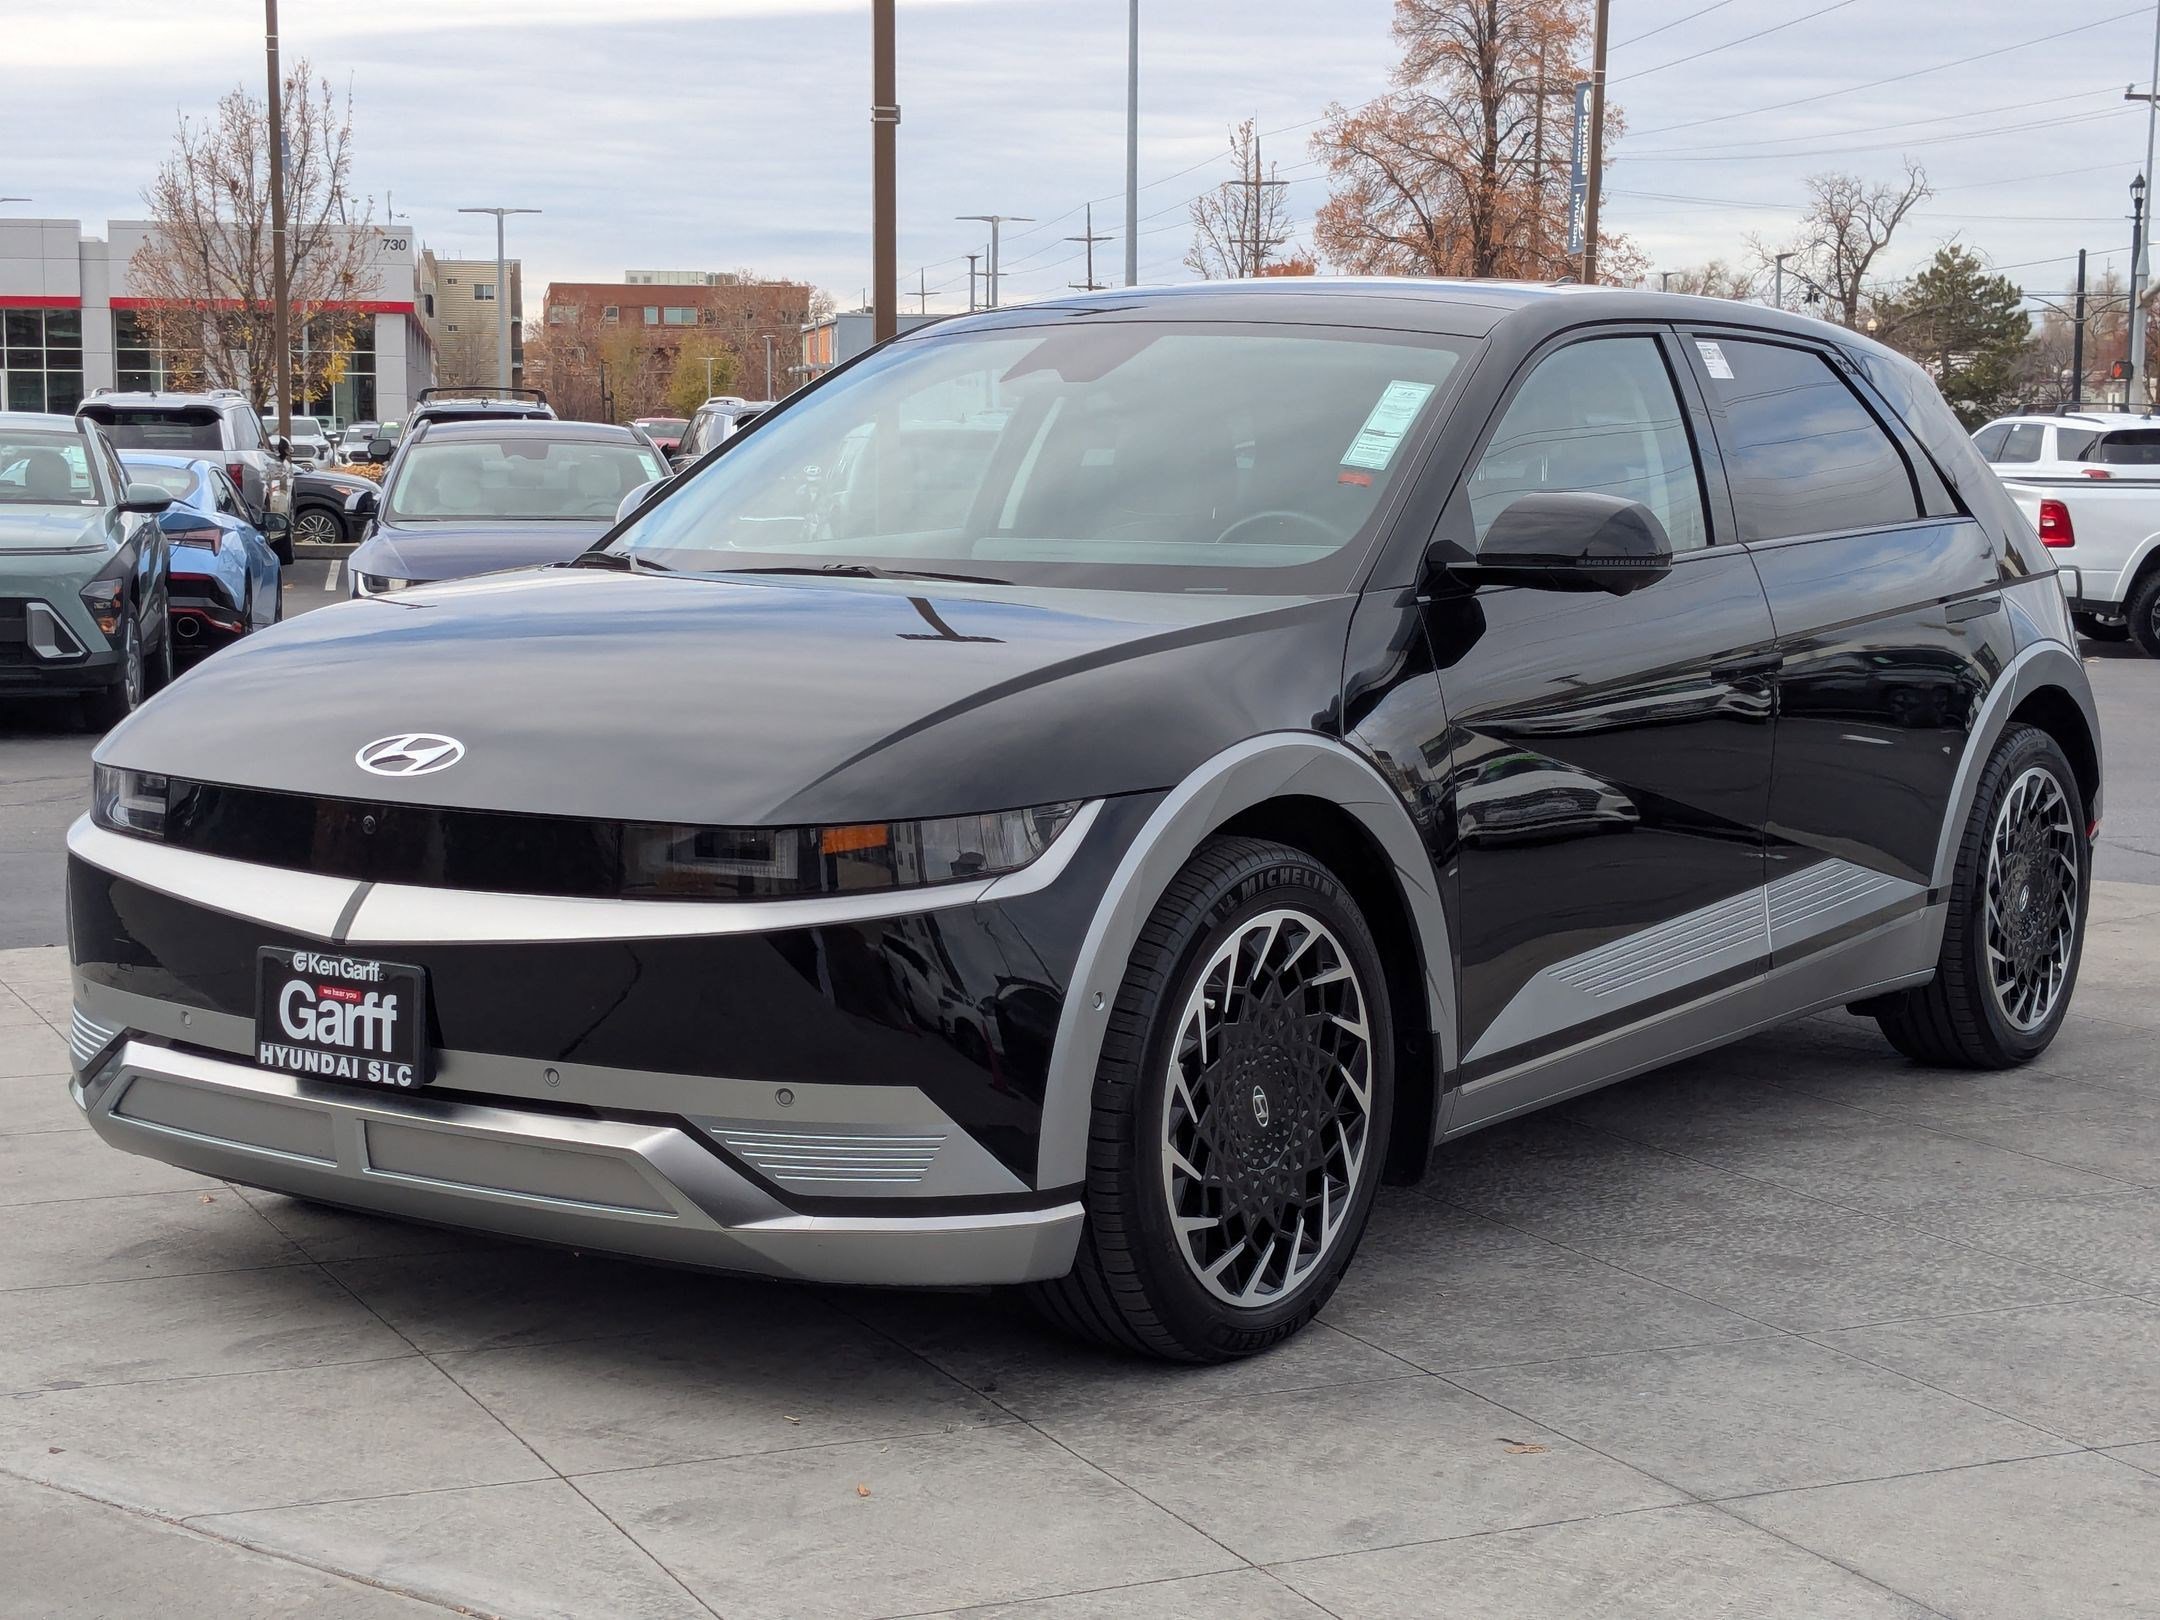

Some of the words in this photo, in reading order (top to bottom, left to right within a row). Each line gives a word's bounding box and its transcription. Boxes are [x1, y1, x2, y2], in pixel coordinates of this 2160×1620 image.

[1581, 114, 1590, 176] Hyundai
[382, 238, 407, 251] 730
[1241, 866, 1335, 901] MICHELIN
[279, 979, 398, 1053] Garff
[260, 1044, 359, 1079] HYUNDAI
[367, 1060, 412, 1087] SLC
